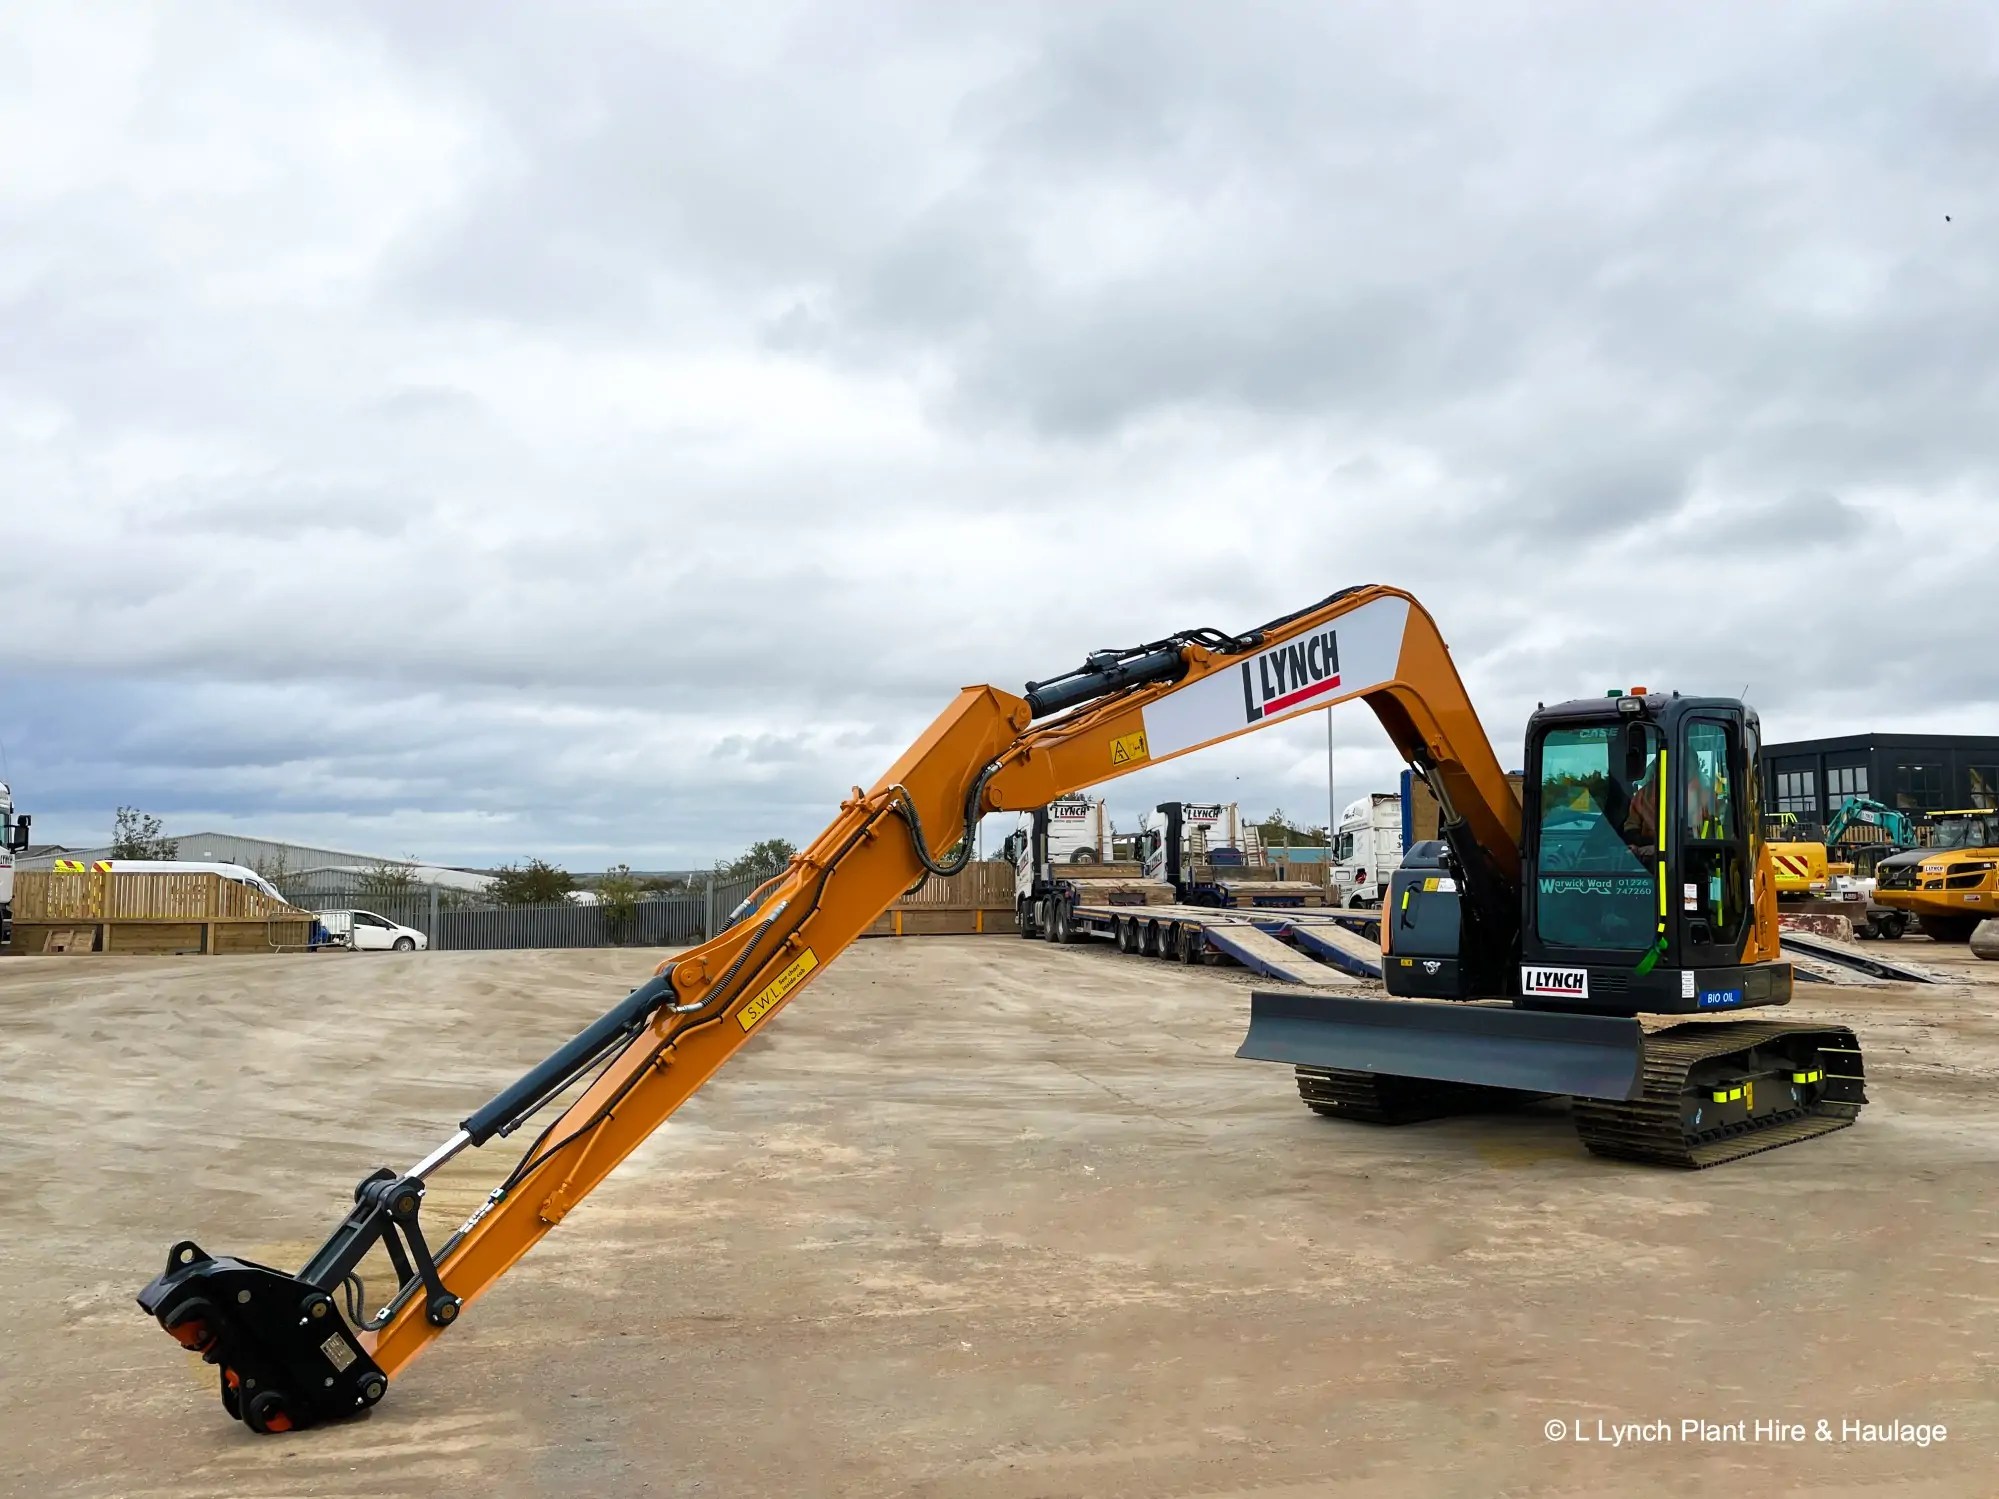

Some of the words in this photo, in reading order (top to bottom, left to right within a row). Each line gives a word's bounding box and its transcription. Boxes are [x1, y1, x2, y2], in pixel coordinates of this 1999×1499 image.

[1241, 660, 1263, 724] L
[1258, 629, 1340, 702] LYNCH
[1060, 807, 1087, 816] LYNCH
[1193, 808, 1219, 818] LYNCH
[1539, 879, 1584, 894] Warwick
[1587, 879, 1612, 888] Ward
[787, 963, 801, 977] chart
[782, 976, 797, 991] inside
[1525, 971, 1535, 991] L
[1535, 971, 1584, 989] LYNCH
[1707, 992, 1721, 1004] BIO
[1722, 992, 1734, 1002] OIL
